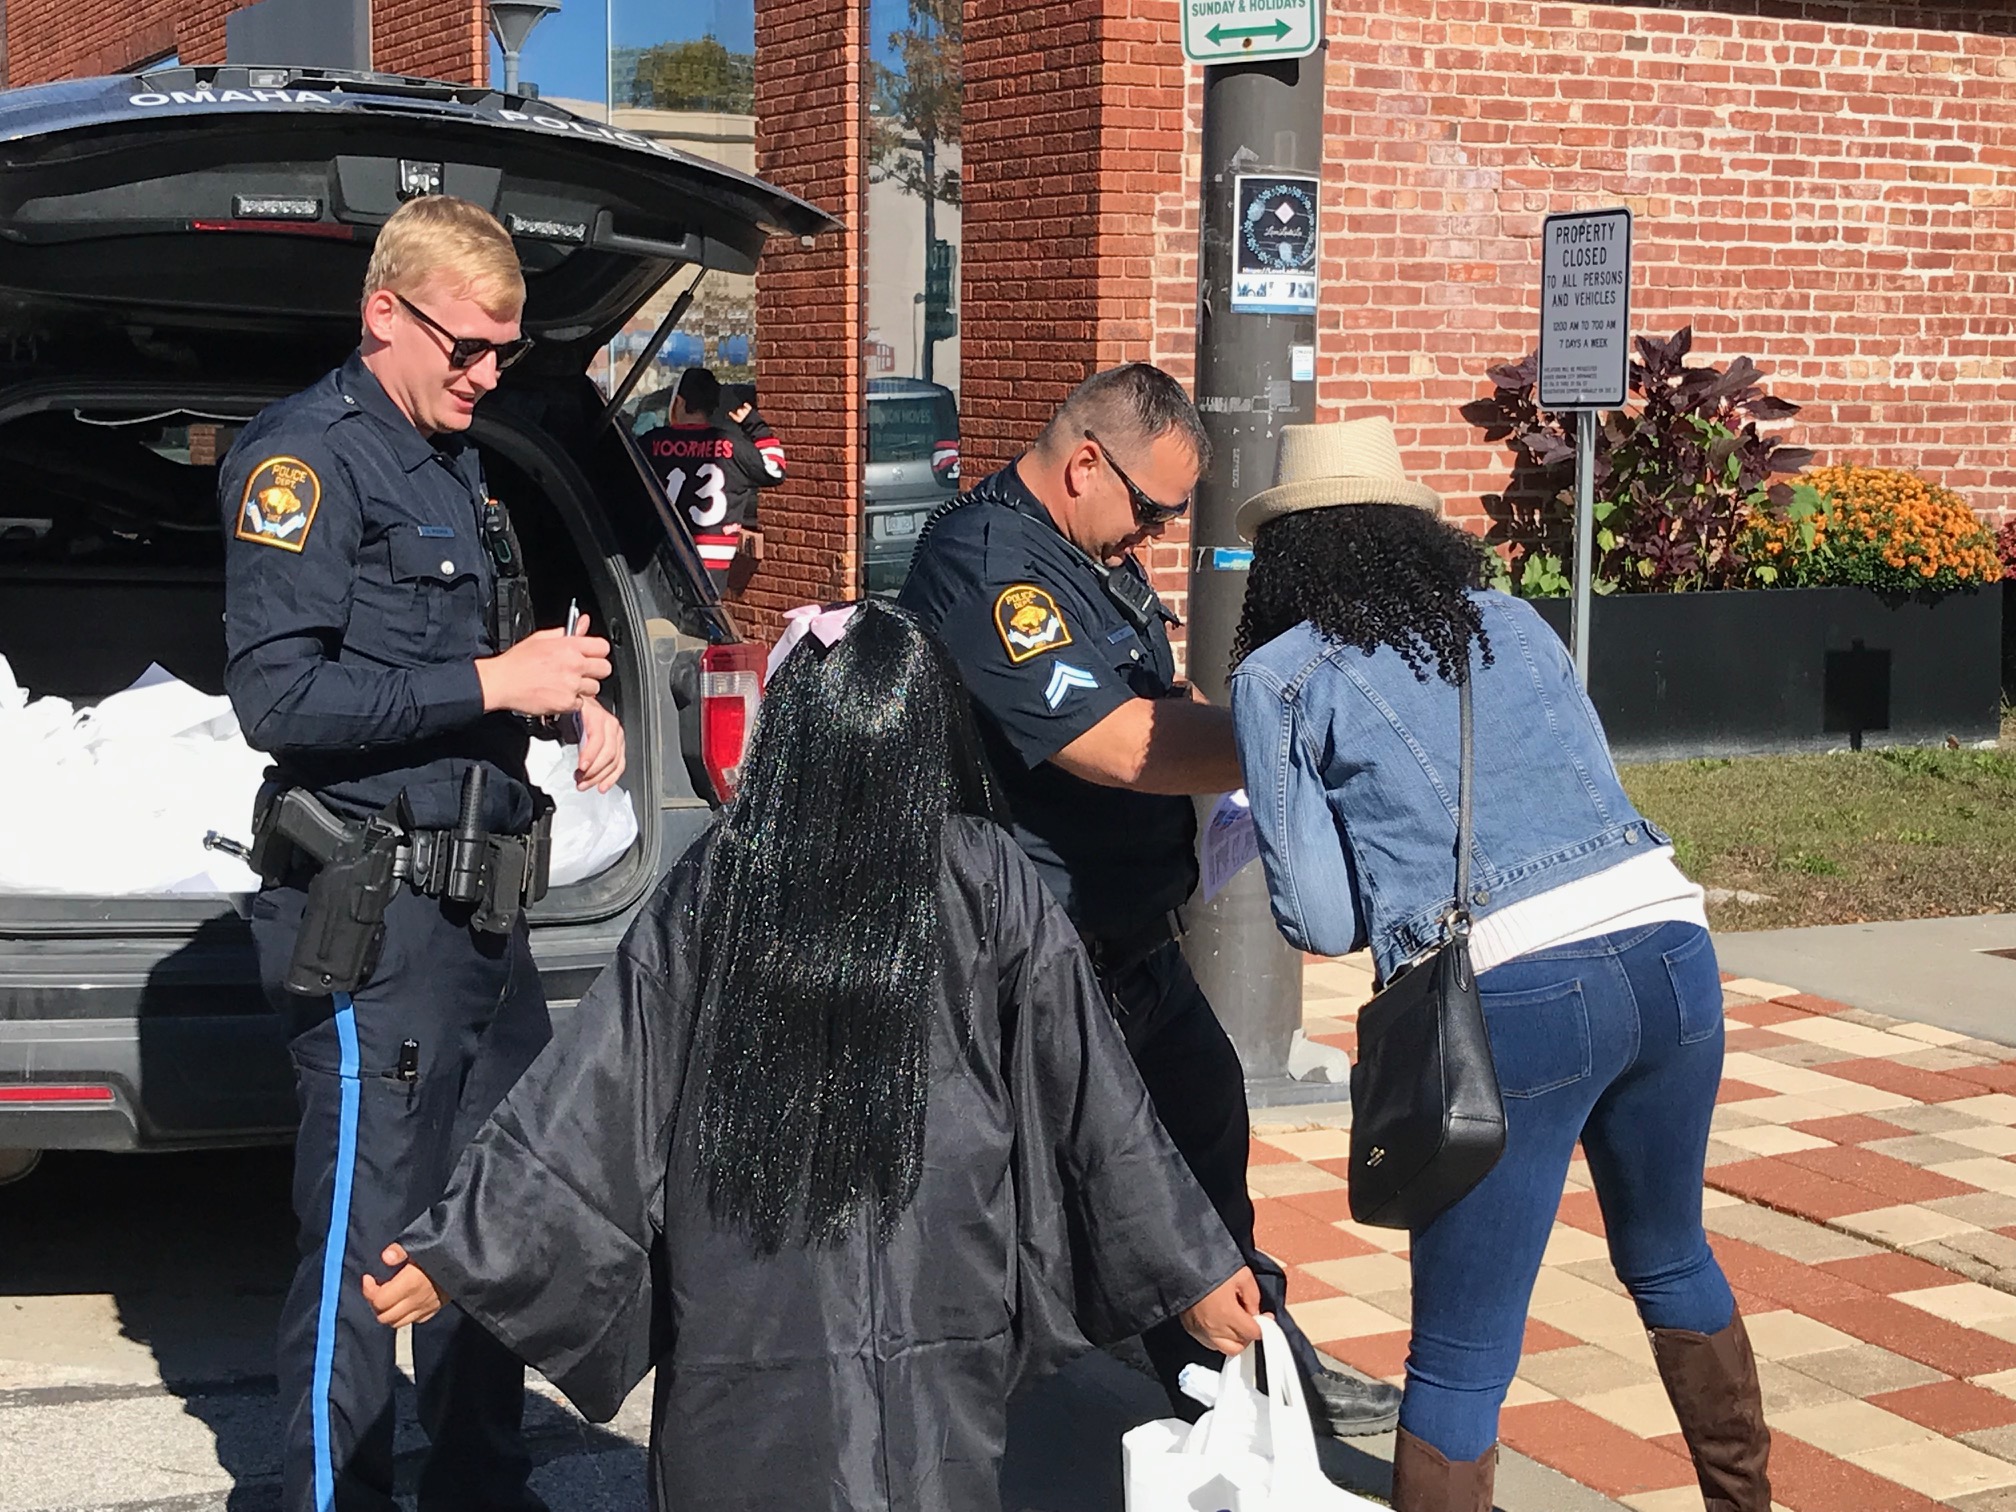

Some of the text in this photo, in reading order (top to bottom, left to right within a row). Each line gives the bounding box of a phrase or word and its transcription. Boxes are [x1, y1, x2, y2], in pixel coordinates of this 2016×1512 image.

[1191, 0, 1306, 17] SUNDAY & HOLIDAYS
[129, 90, 331, 106] OMAHA
[498, 109, 681, 157] POLICE
[1556, 222, 1615, 245] PROPERTY
[1562, 246, 1607, 268] CLOSED
[1547, 270, 1623, 289] TO ALL PERSONS
[1552, 290, 1616, 307] AND VEHICLES
[1569, 321, 1579, 331] AM
[1581, 320, 1590, 330] TO
[1606, 319, 1617, 330] AM
[1559, 338, 1608, 349] 7 DAYS A WEEK
[652, 439, 733, 458] VOORHEES
[271, 464, 307, 484] POLICE
[666, 463, 728, 527] 13
[1005, 591, 1037, 605] POLICE
